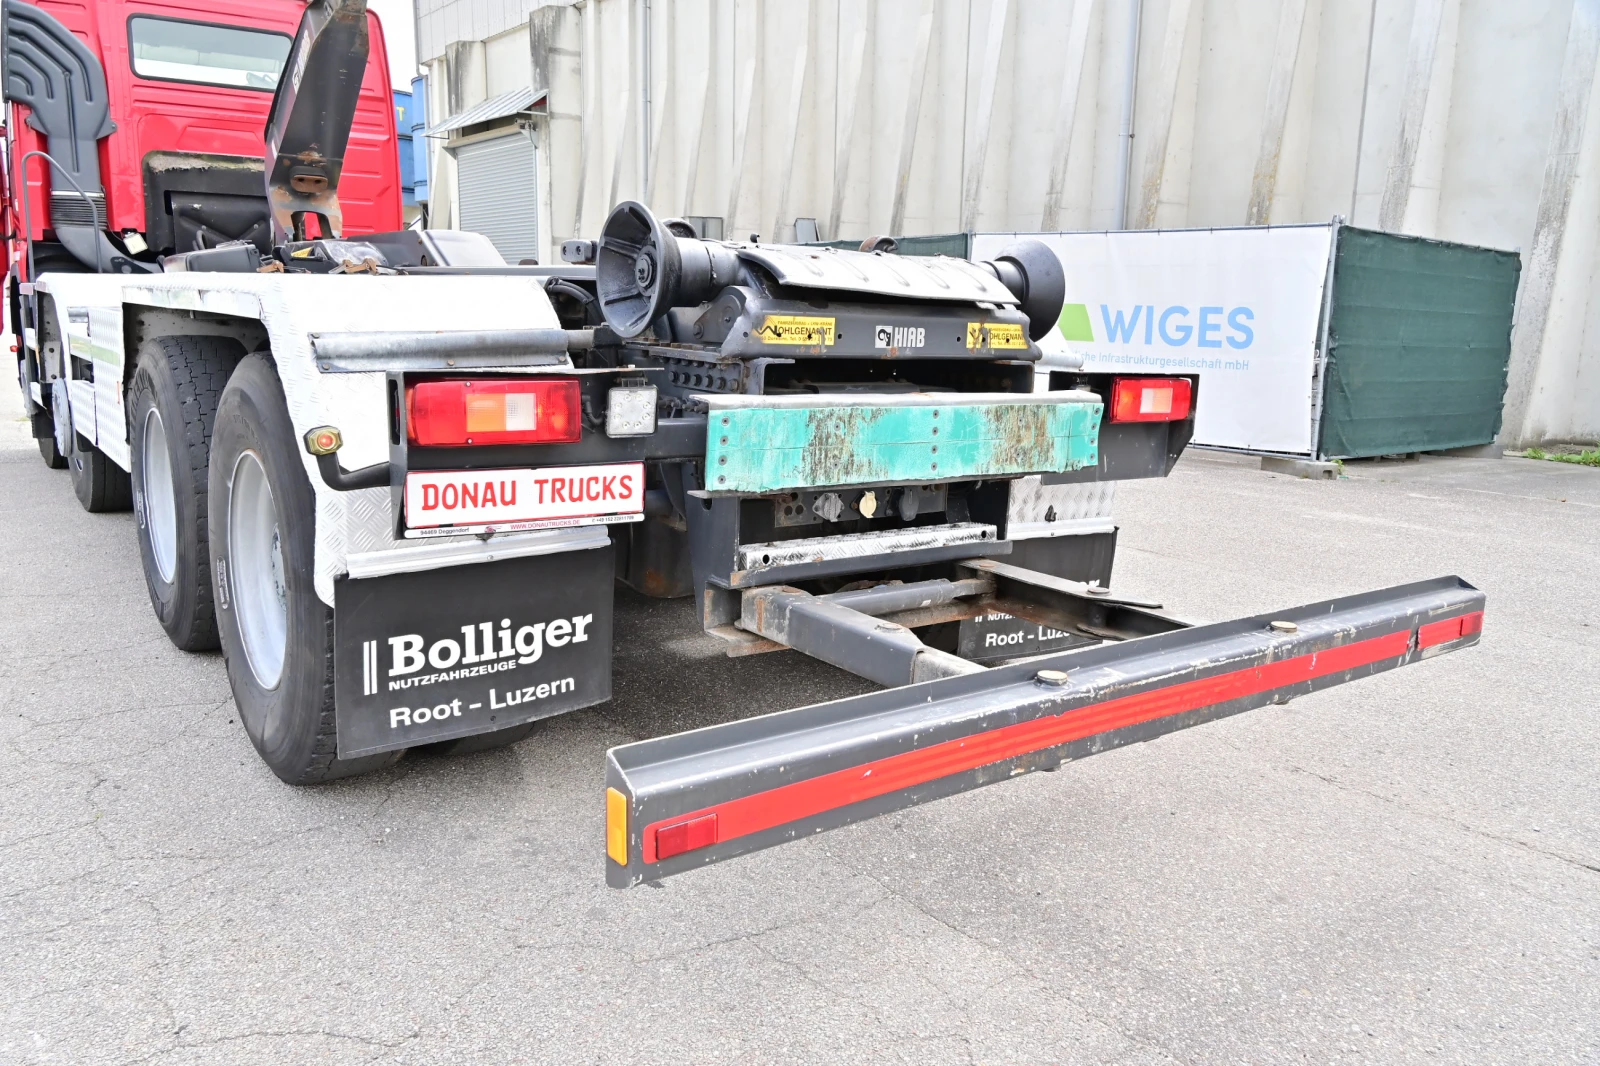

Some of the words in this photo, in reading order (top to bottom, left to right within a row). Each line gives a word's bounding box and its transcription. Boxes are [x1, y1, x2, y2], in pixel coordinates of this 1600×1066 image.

[894, 327, 925, 347] HIAB
[1100, 304, 1254, 350] WIGES
[1100, 352, 1221, 369] Infrastrukturgesellschaft
[1225, 359, 1249, 370] mbH
[421, 480, 517, 511] DONAU
[534, 474, 633, 504] TRUCKS
[510, 519, 580, 530] WWW.DONAUTRUCKS.DE
[388, 613, 592, 677] Bolliger
[985, 630, 1025, 647] Root
[388, 659, 517, 691] NUTZFAHRZEUGE
[390, 698, 462, 728] Root
[489, 677, 575, 710] Luzern
